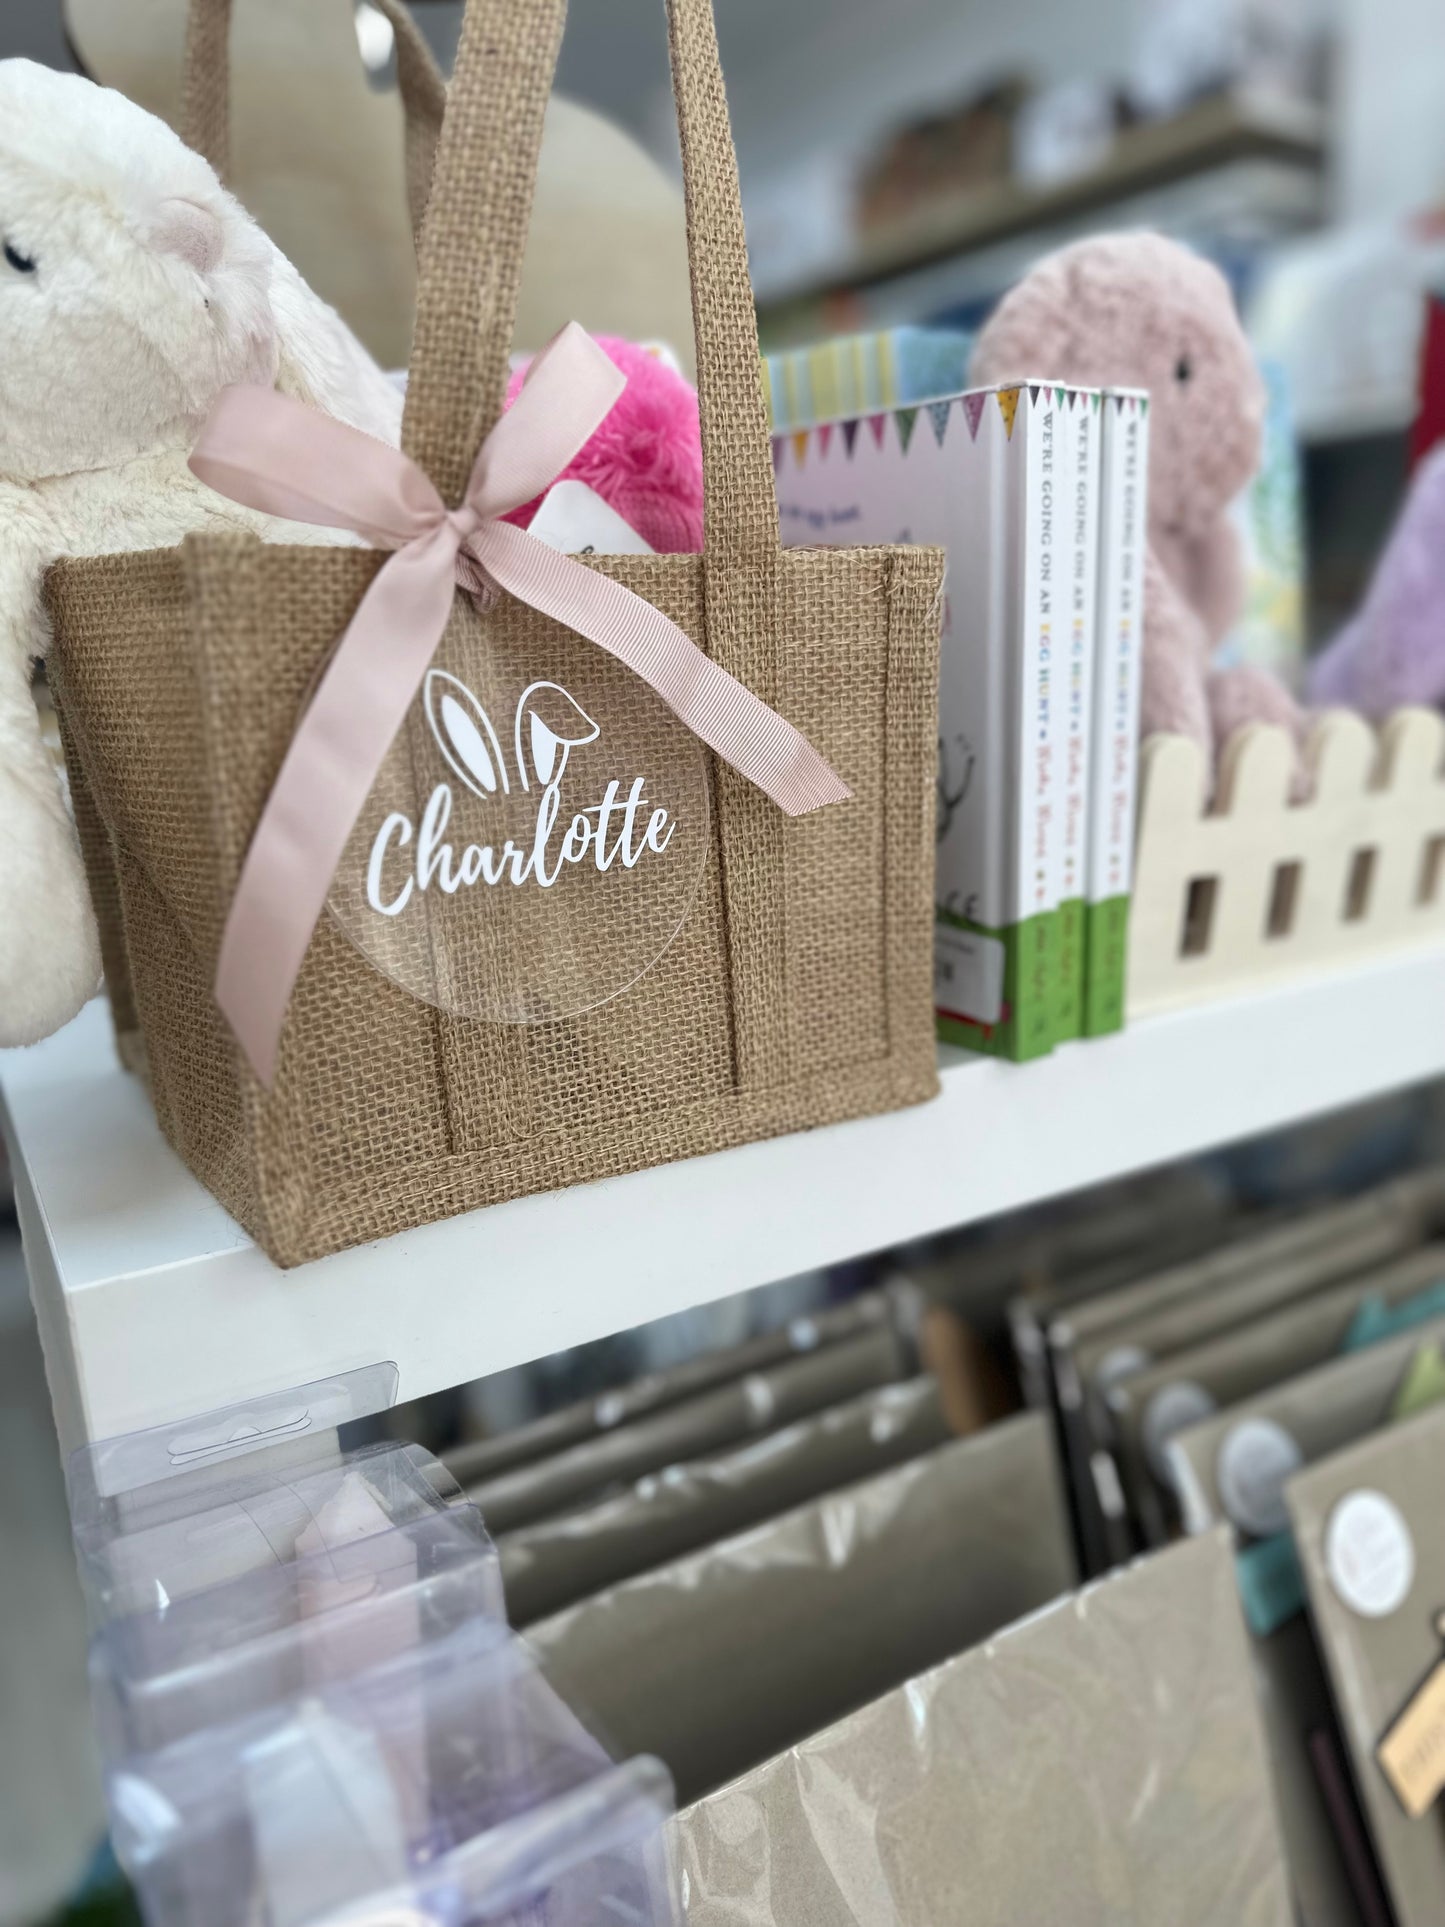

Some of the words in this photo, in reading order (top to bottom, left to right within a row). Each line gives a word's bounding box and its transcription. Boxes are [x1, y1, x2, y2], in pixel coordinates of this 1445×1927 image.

[1042, 411, 1053, 474] WE'RE
[1041, 480, 1052, 546] GOING
[1075, 481, 1087, 545] GOING
[1041, 553, 1051, 581] ON
[1040, 589, 1050, 614] AN
[1039, 623, 1051, 662] EGG
[1038, 668, 1049, 722] HUNT
[367, 777, 676, 916] Charlotte
